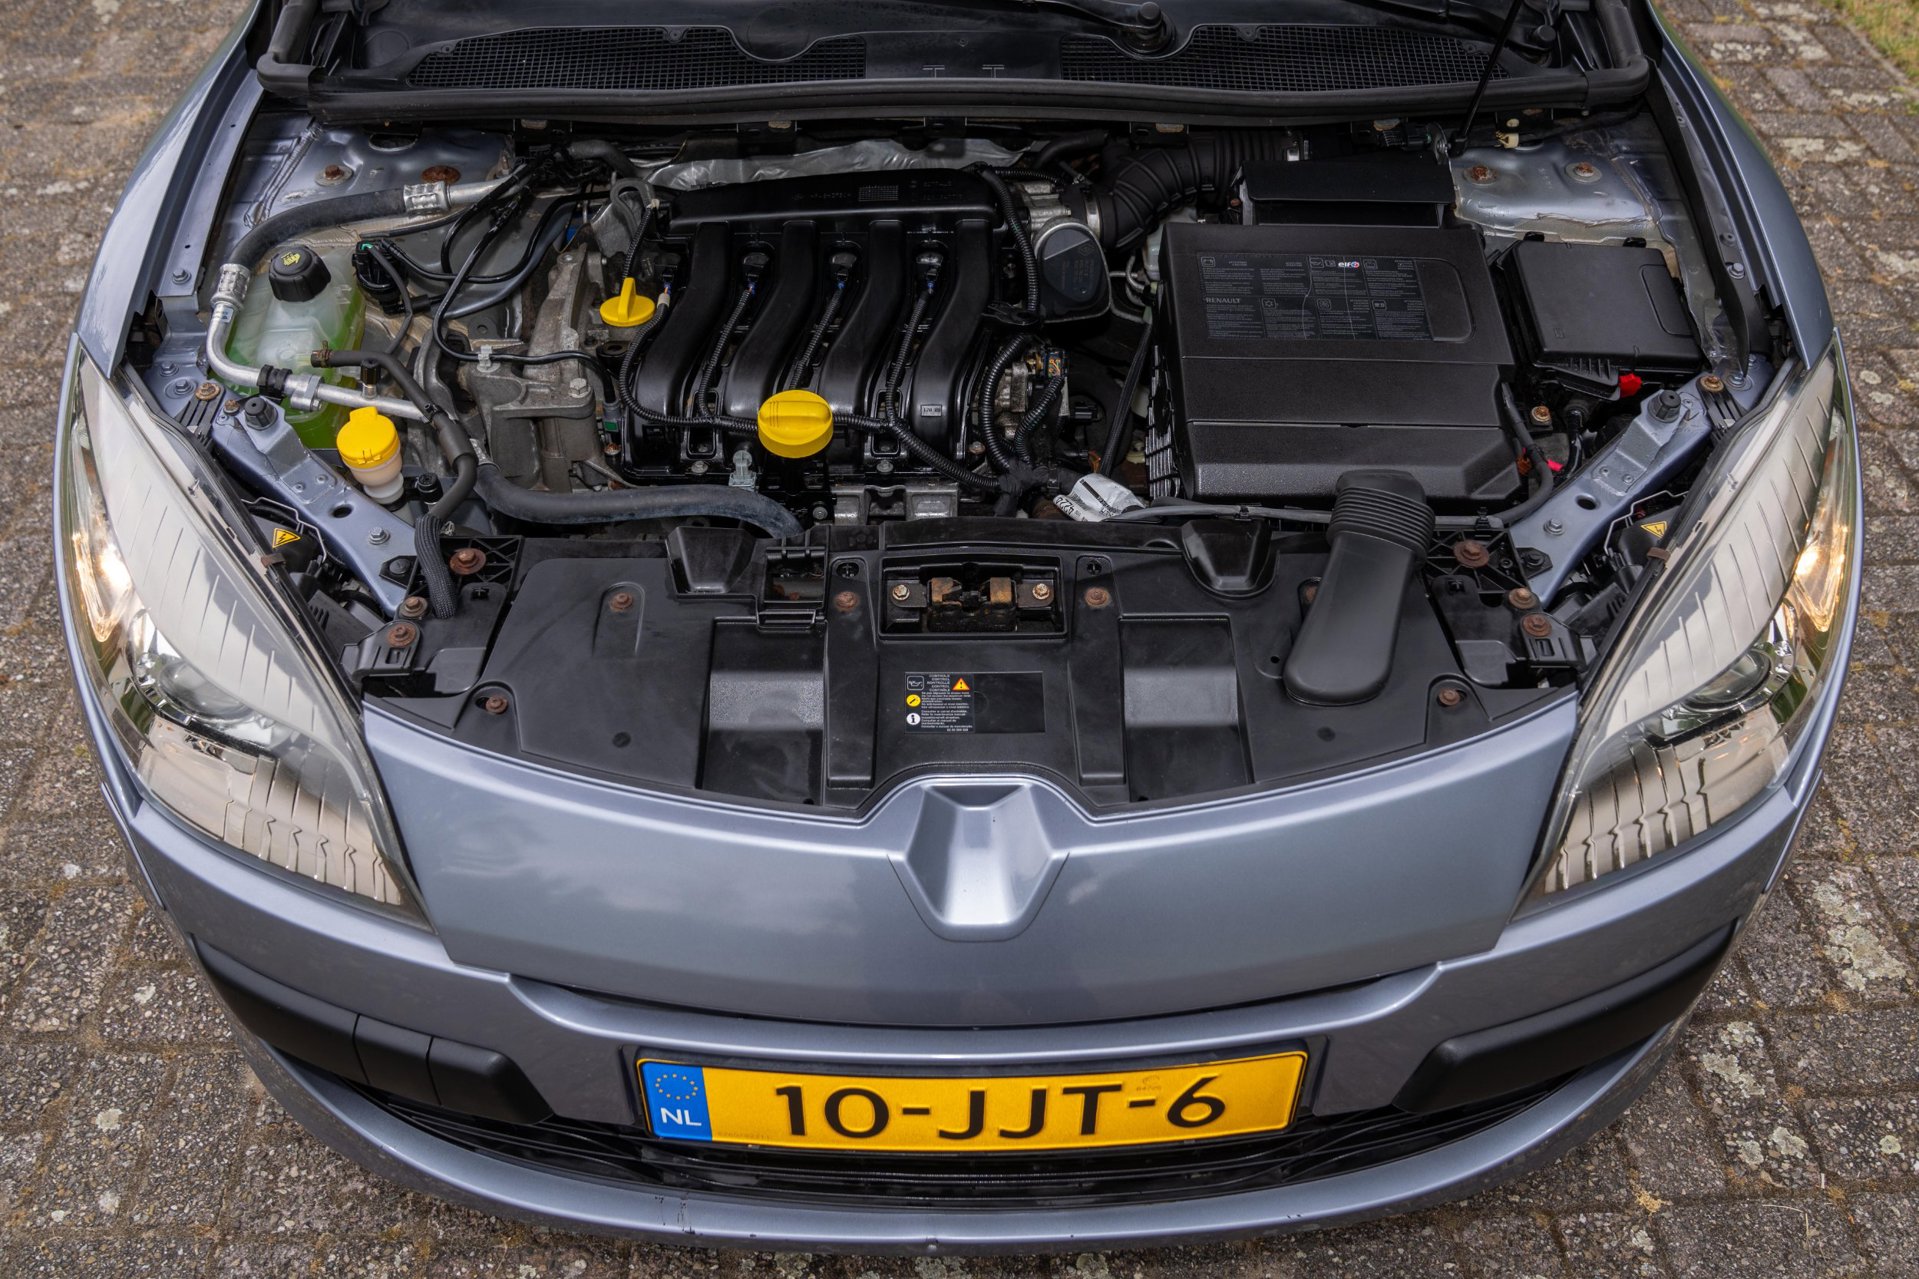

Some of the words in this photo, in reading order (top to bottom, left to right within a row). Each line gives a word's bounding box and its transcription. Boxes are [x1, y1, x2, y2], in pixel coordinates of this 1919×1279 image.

[1205, 296, 1241, 304] RENAULT
[775, 1074, 1226, 1139] 10-JJT-6
[660, 1107, 702, 1127] NL
